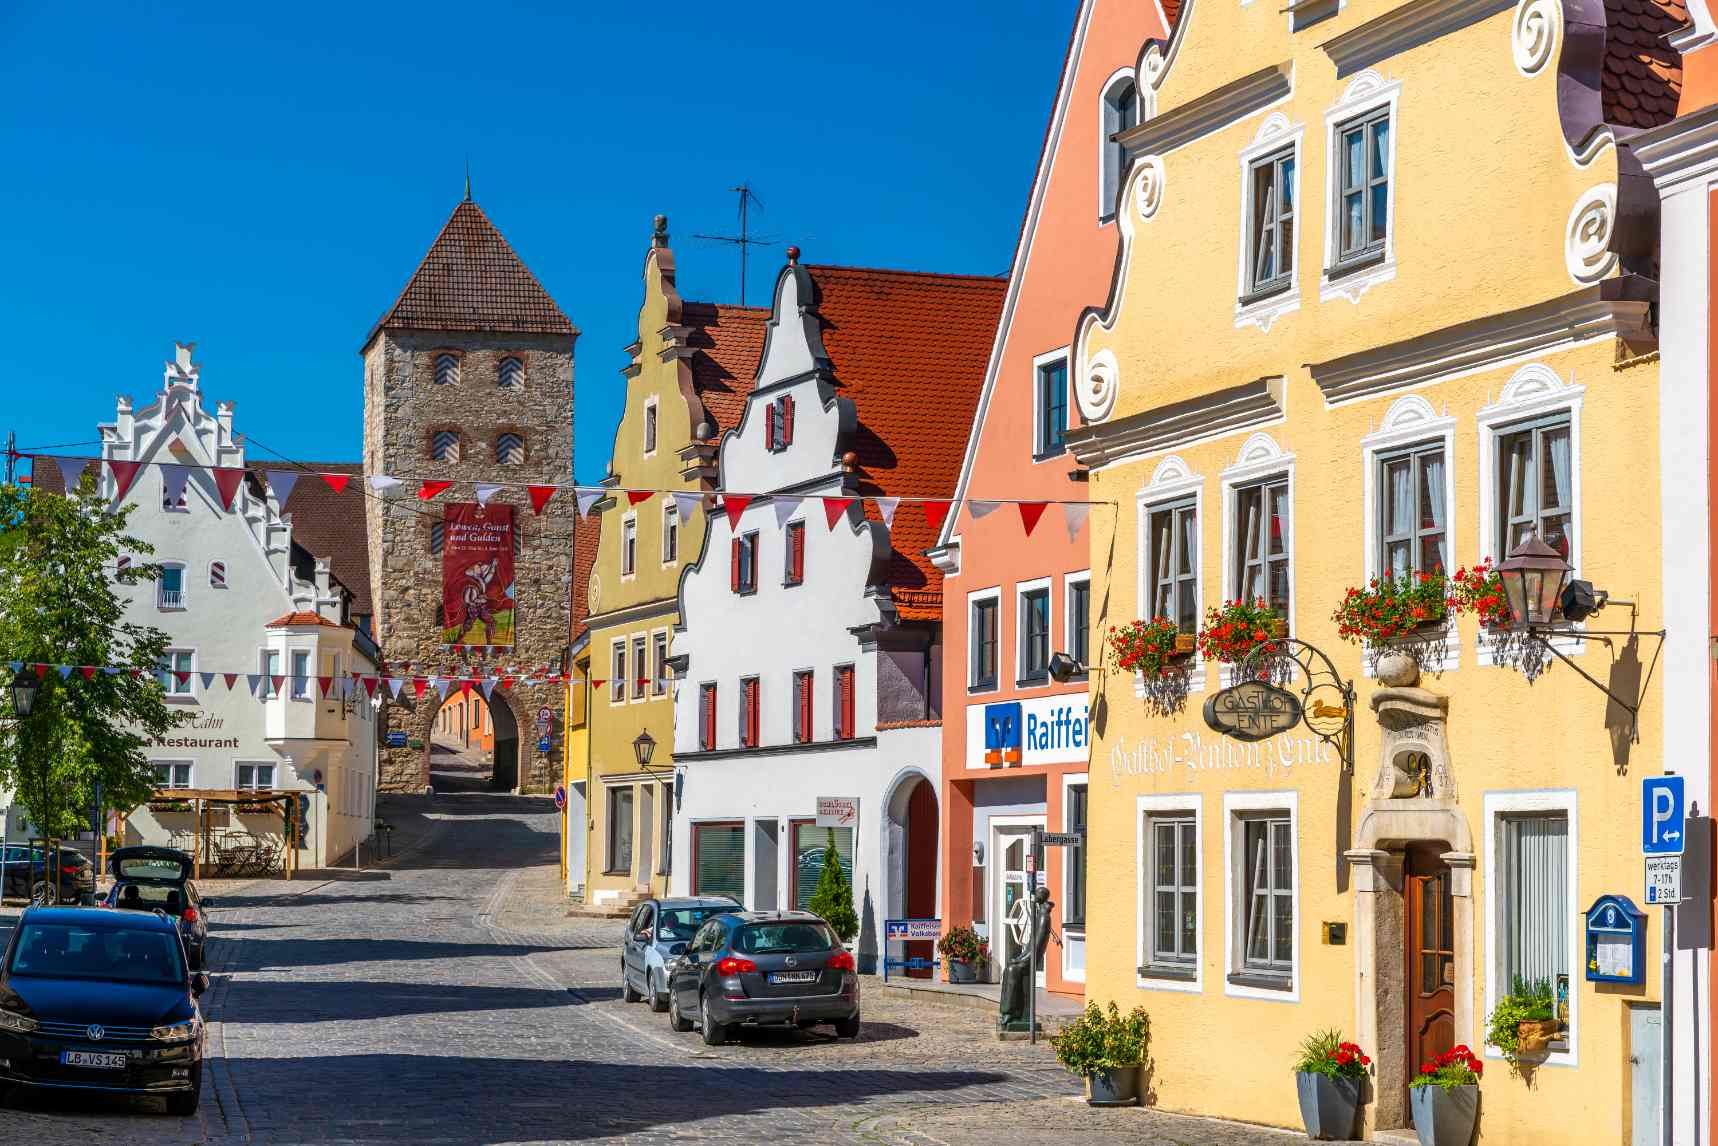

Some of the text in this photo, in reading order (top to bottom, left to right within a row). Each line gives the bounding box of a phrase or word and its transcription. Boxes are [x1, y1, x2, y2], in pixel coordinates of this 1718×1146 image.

[449, 533, 467, 542] und
[1223, 688, 1290, 713] GASTHOF
[1238, 712, 1280, 729] ENTE
[157, 737, 240, 748] Restaurant
[1652, 786, 1675, 843] P
[1040, 832, 1079, 845] Labergasse
[1647, 861, 1679, 873] werktags
